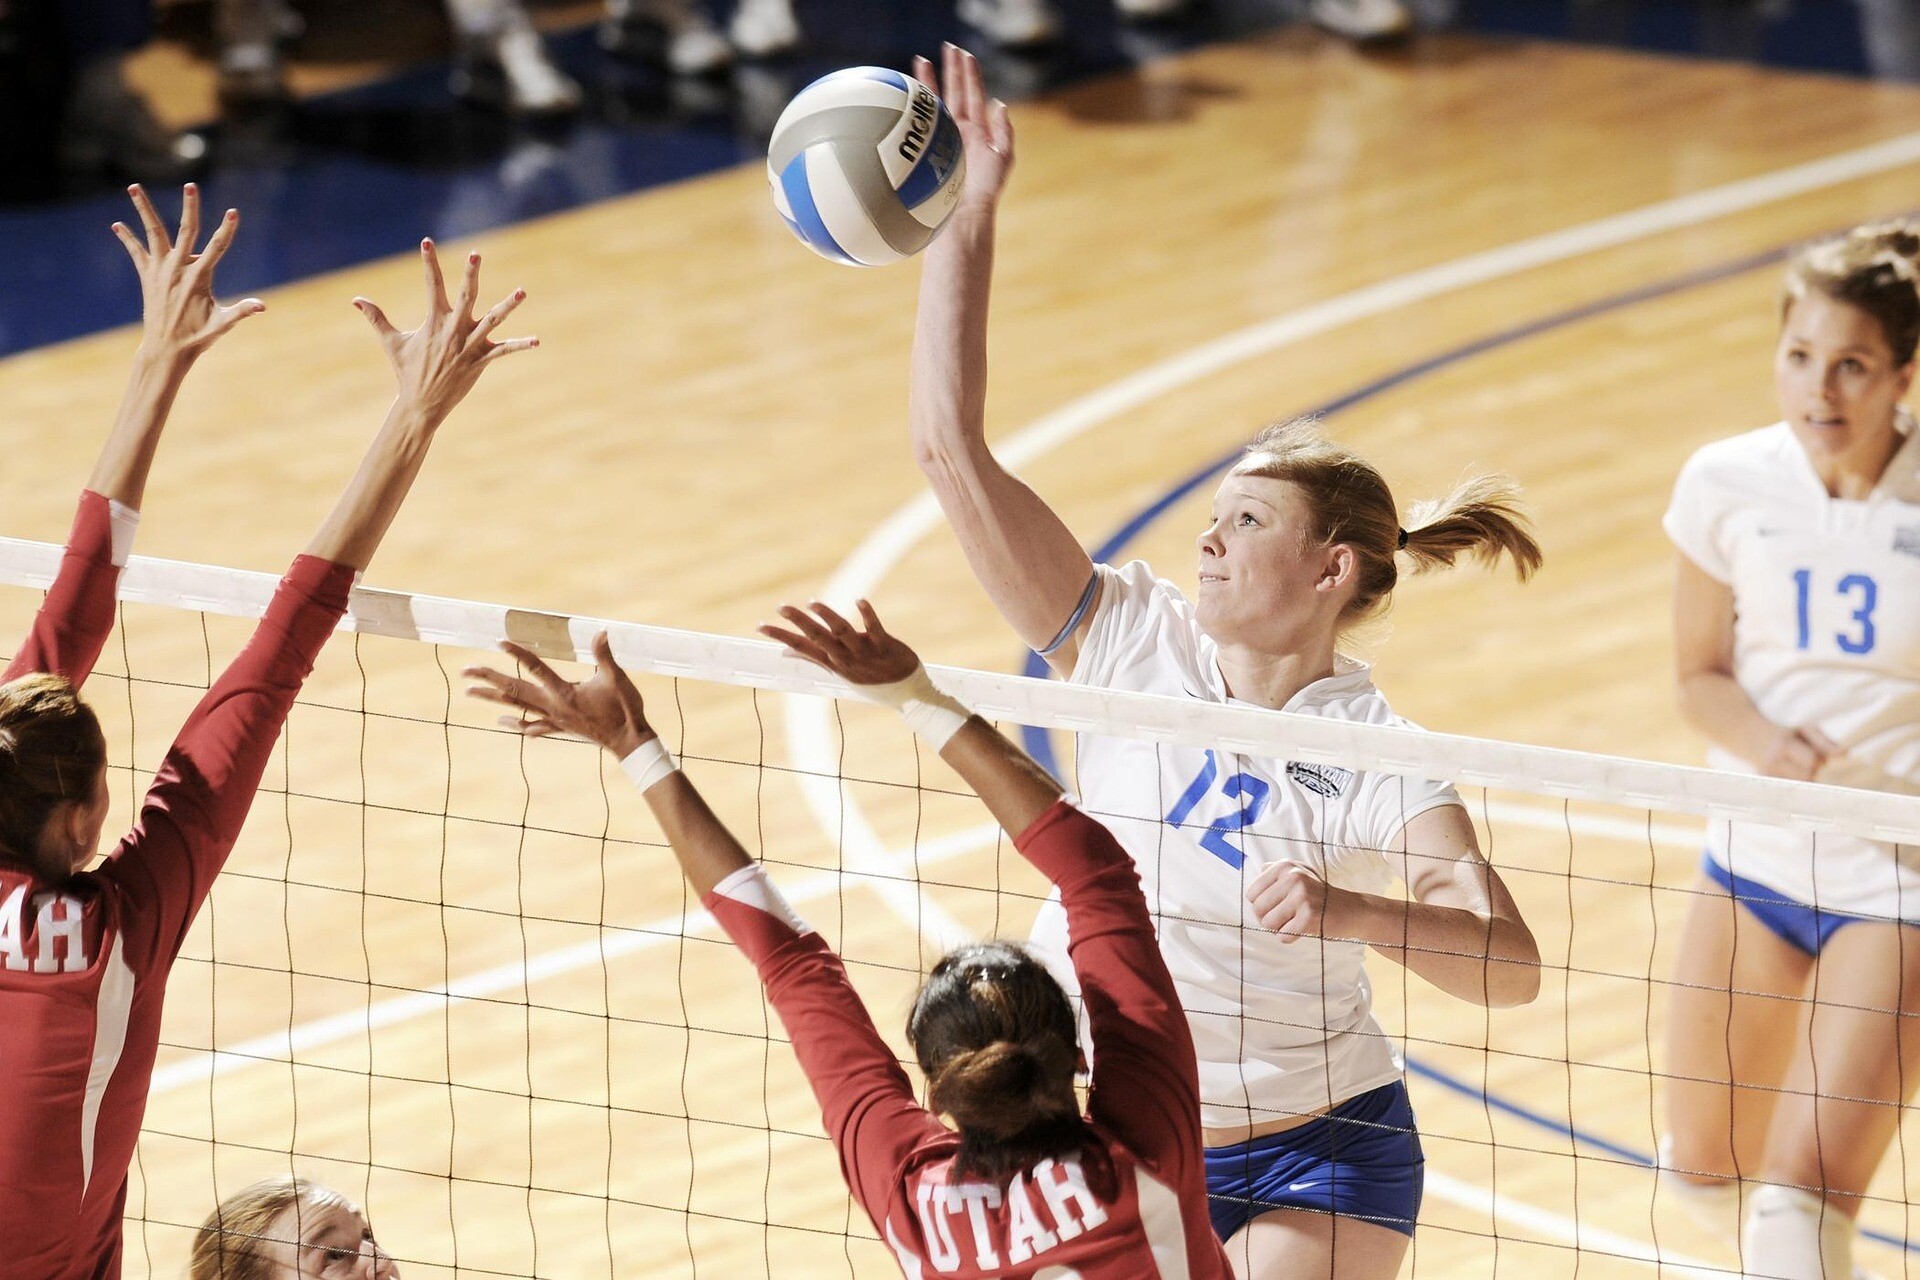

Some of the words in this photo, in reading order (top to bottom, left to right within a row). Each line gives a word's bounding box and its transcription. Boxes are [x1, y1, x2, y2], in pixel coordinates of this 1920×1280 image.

[1794, 569, 1877, 655] 13
[1164, 749, 1270, 870] 12
[1293, 769, 1340, 798] WEST
[0, 881, 88, 973] AH
[917, 1154, 1108, 1272] UTAH
